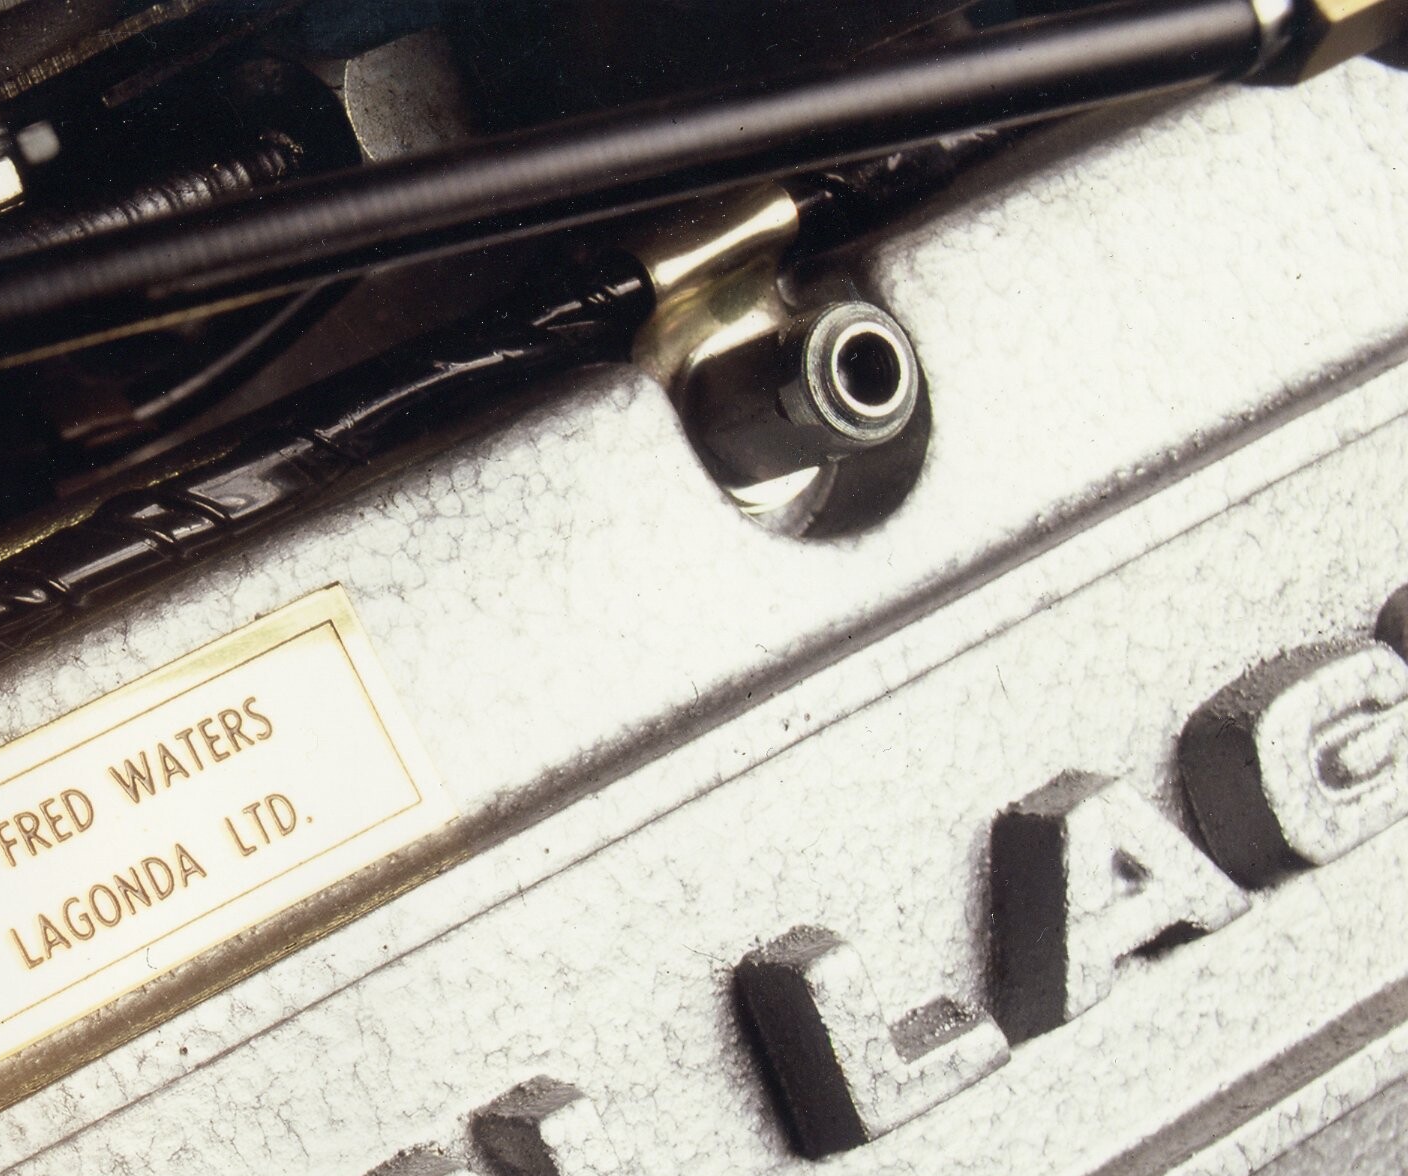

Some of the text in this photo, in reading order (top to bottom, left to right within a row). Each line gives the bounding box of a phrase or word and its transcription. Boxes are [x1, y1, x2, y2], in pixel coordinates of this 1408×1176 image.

[108, 696, 274, 804] WATERS
[10, 842, 208, 971] LAGONDA
[224, 792, 314, 858] LTD.
[732, 590, 1408, 1160] LAG
